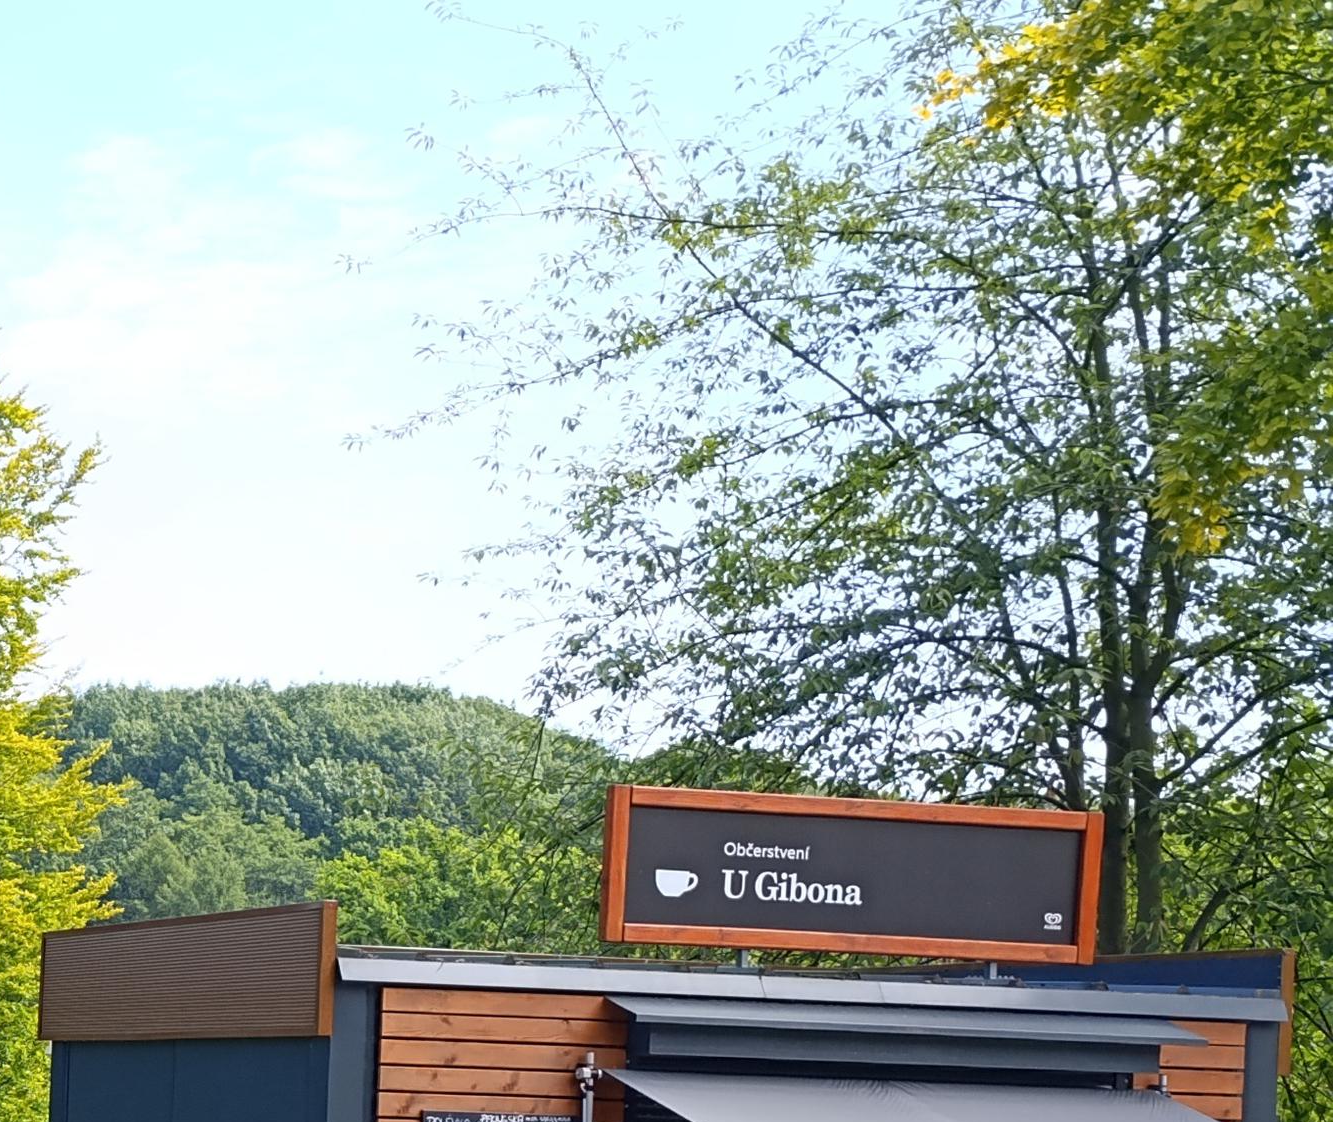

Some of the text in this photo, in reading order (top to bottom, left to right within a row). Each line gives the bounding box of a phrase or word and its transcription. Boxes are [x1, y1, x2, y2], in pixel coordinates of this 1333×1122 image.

[724, 841, 810, 862] Občerstvení
[721, 869, 863, 906] U Gibona
